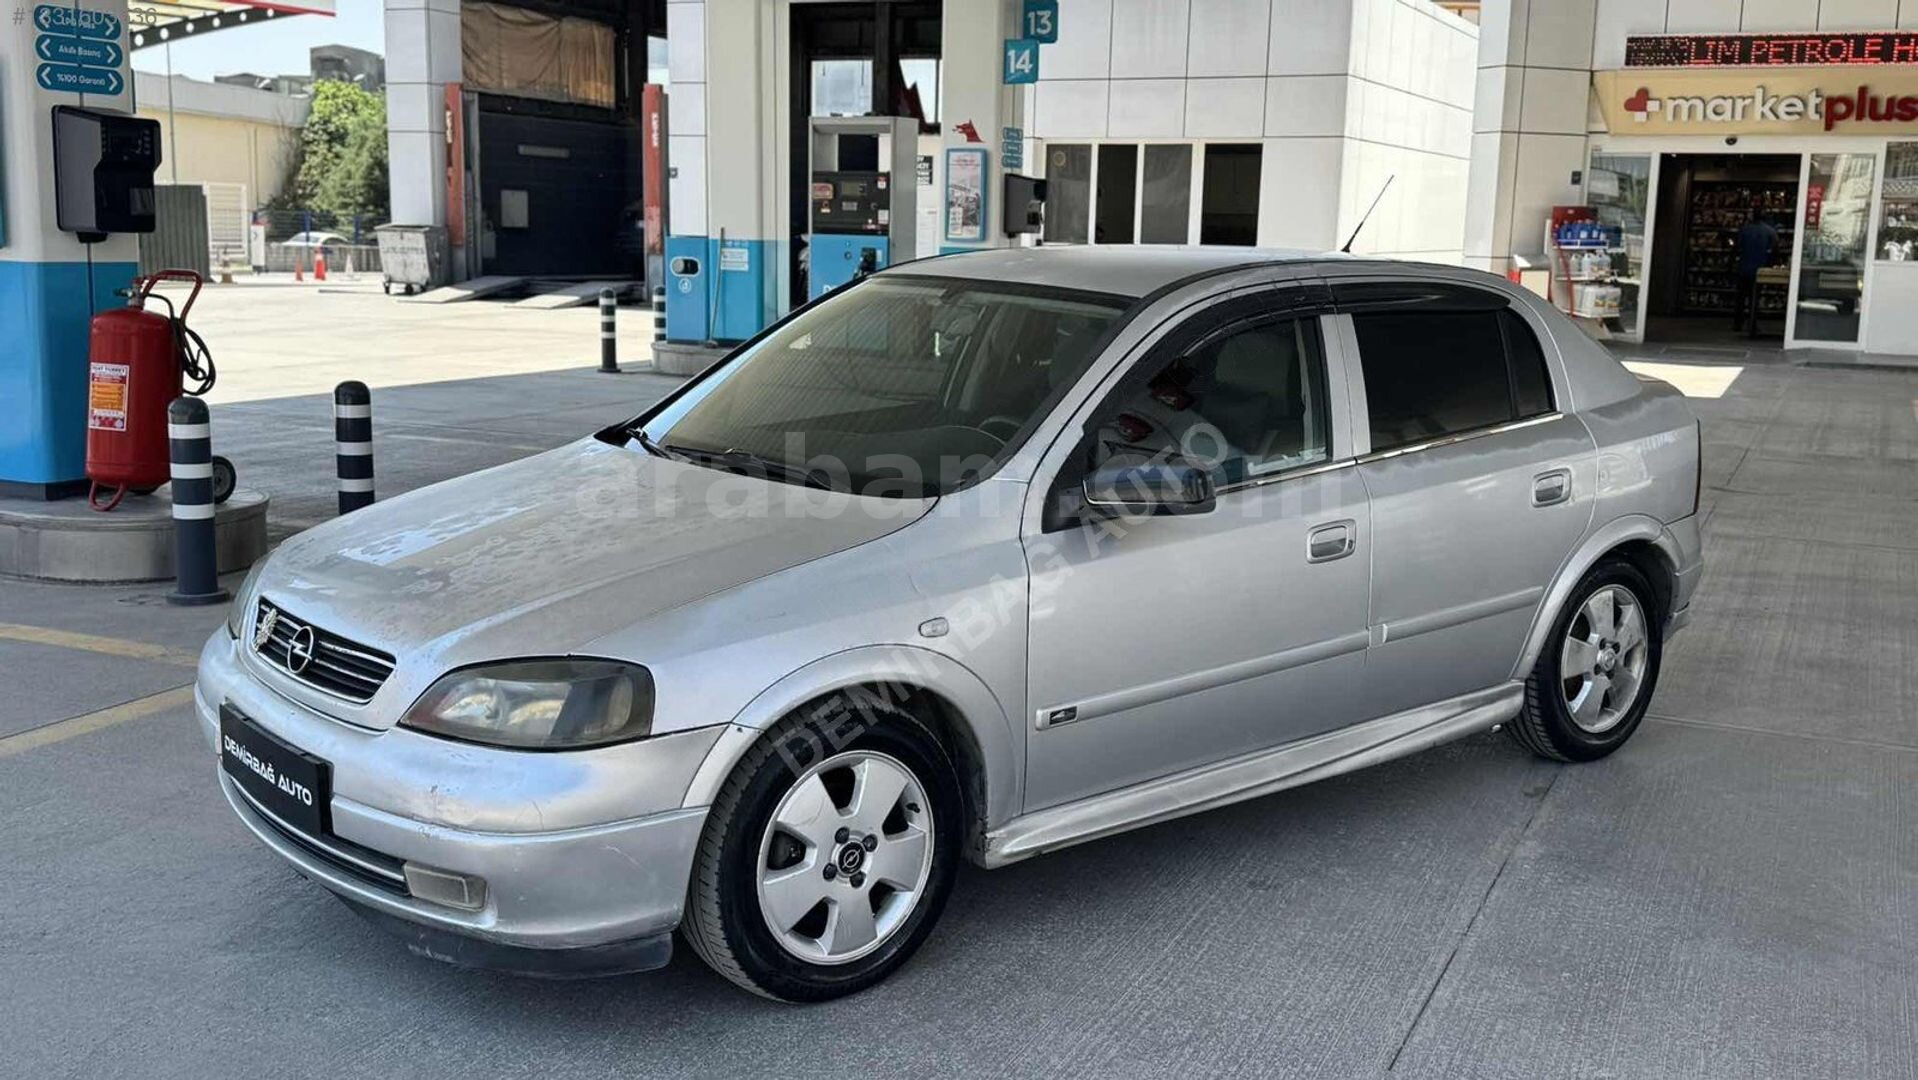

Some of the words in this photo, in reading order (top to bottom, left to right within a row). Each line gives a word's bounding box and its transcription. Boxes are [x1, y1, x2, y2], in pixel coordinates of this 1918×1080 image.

[1028, 10, 1052, 35] 13
[1007, 49, 1033, 74] 14
[1750, 38, 1883, 63] PETROLE
[224, 734, 276, 785] DEMİRBAĞ
[277, 773, 313, 806] AUTO
